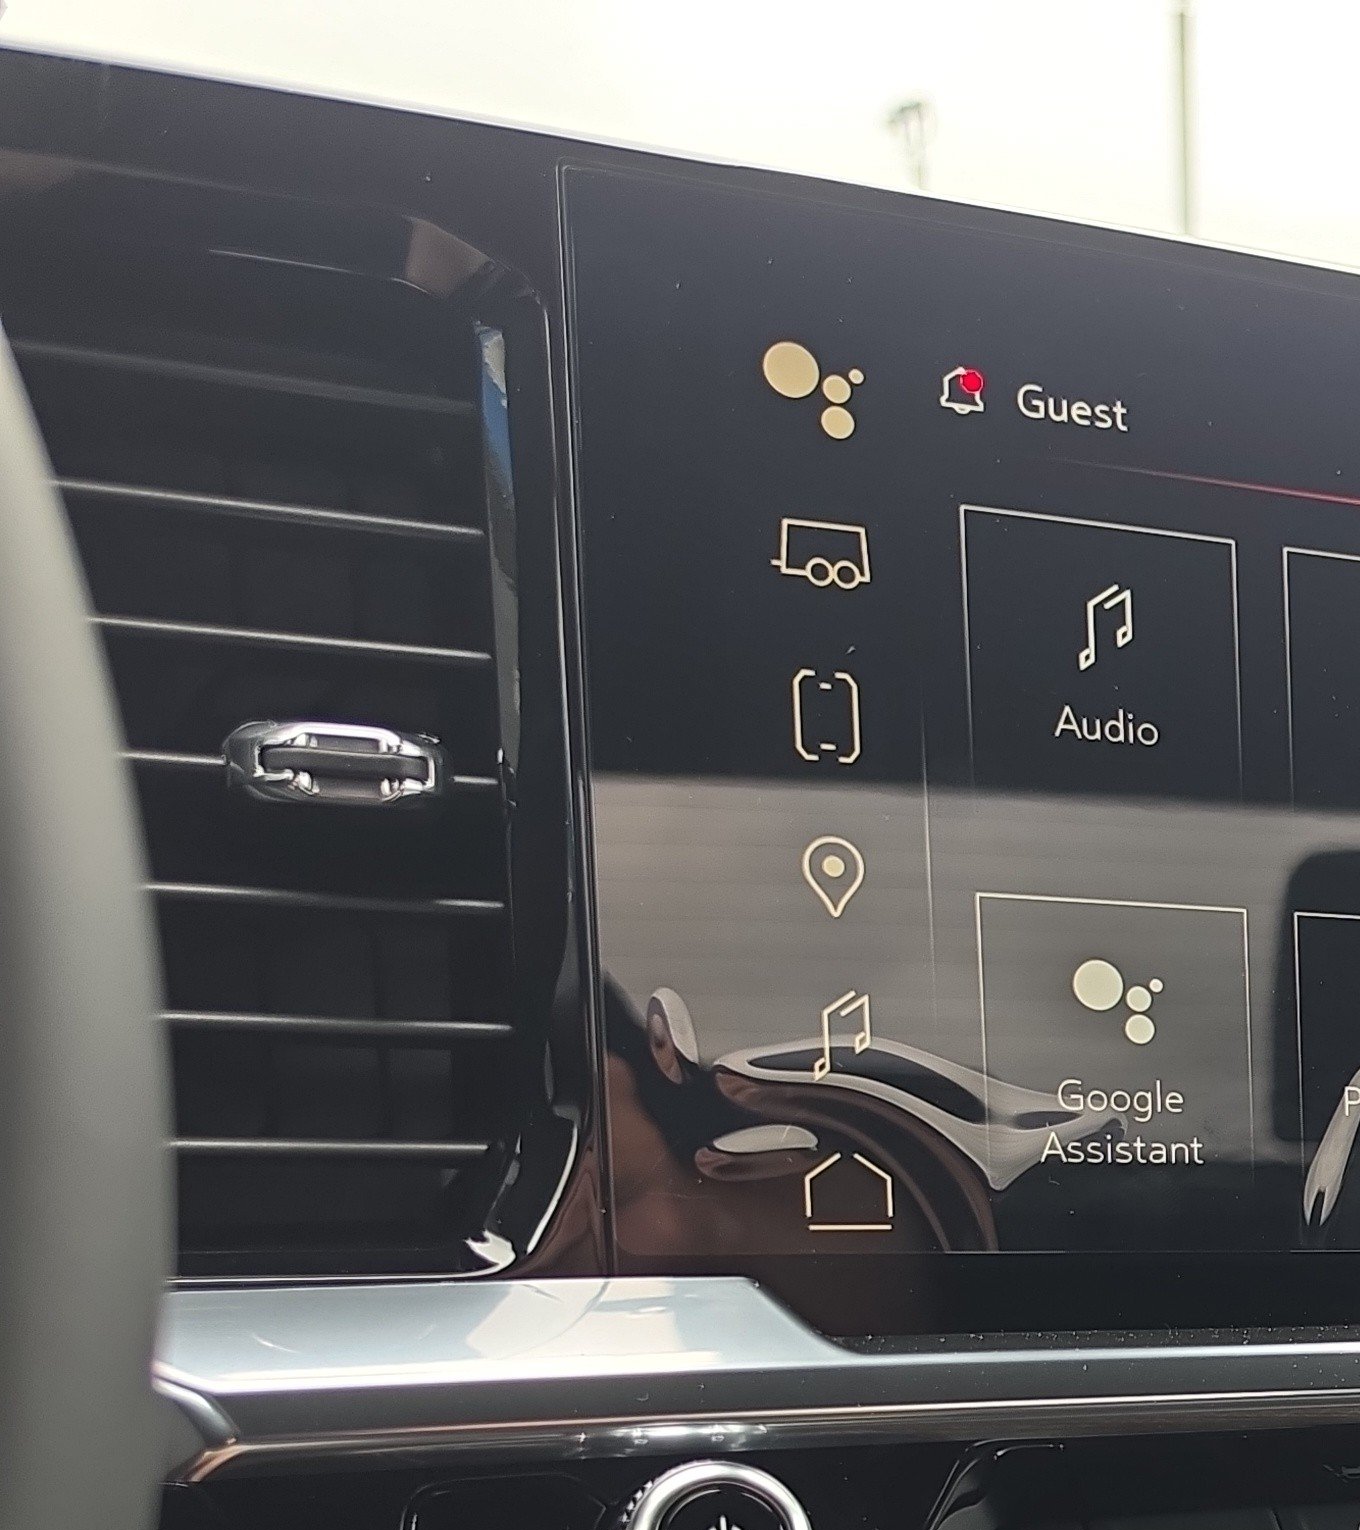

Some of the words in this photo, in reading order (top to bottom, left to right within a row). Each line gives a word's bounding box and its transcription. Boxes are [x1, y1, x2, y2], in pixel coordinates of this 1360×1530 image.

[1017, 385, 1129, 432] Guest
[1054, 706, 1160, 747] Audio
[1057, 1079, 1184, 1122] Google
[1040, 1131, 1204, 1165] Assistant
